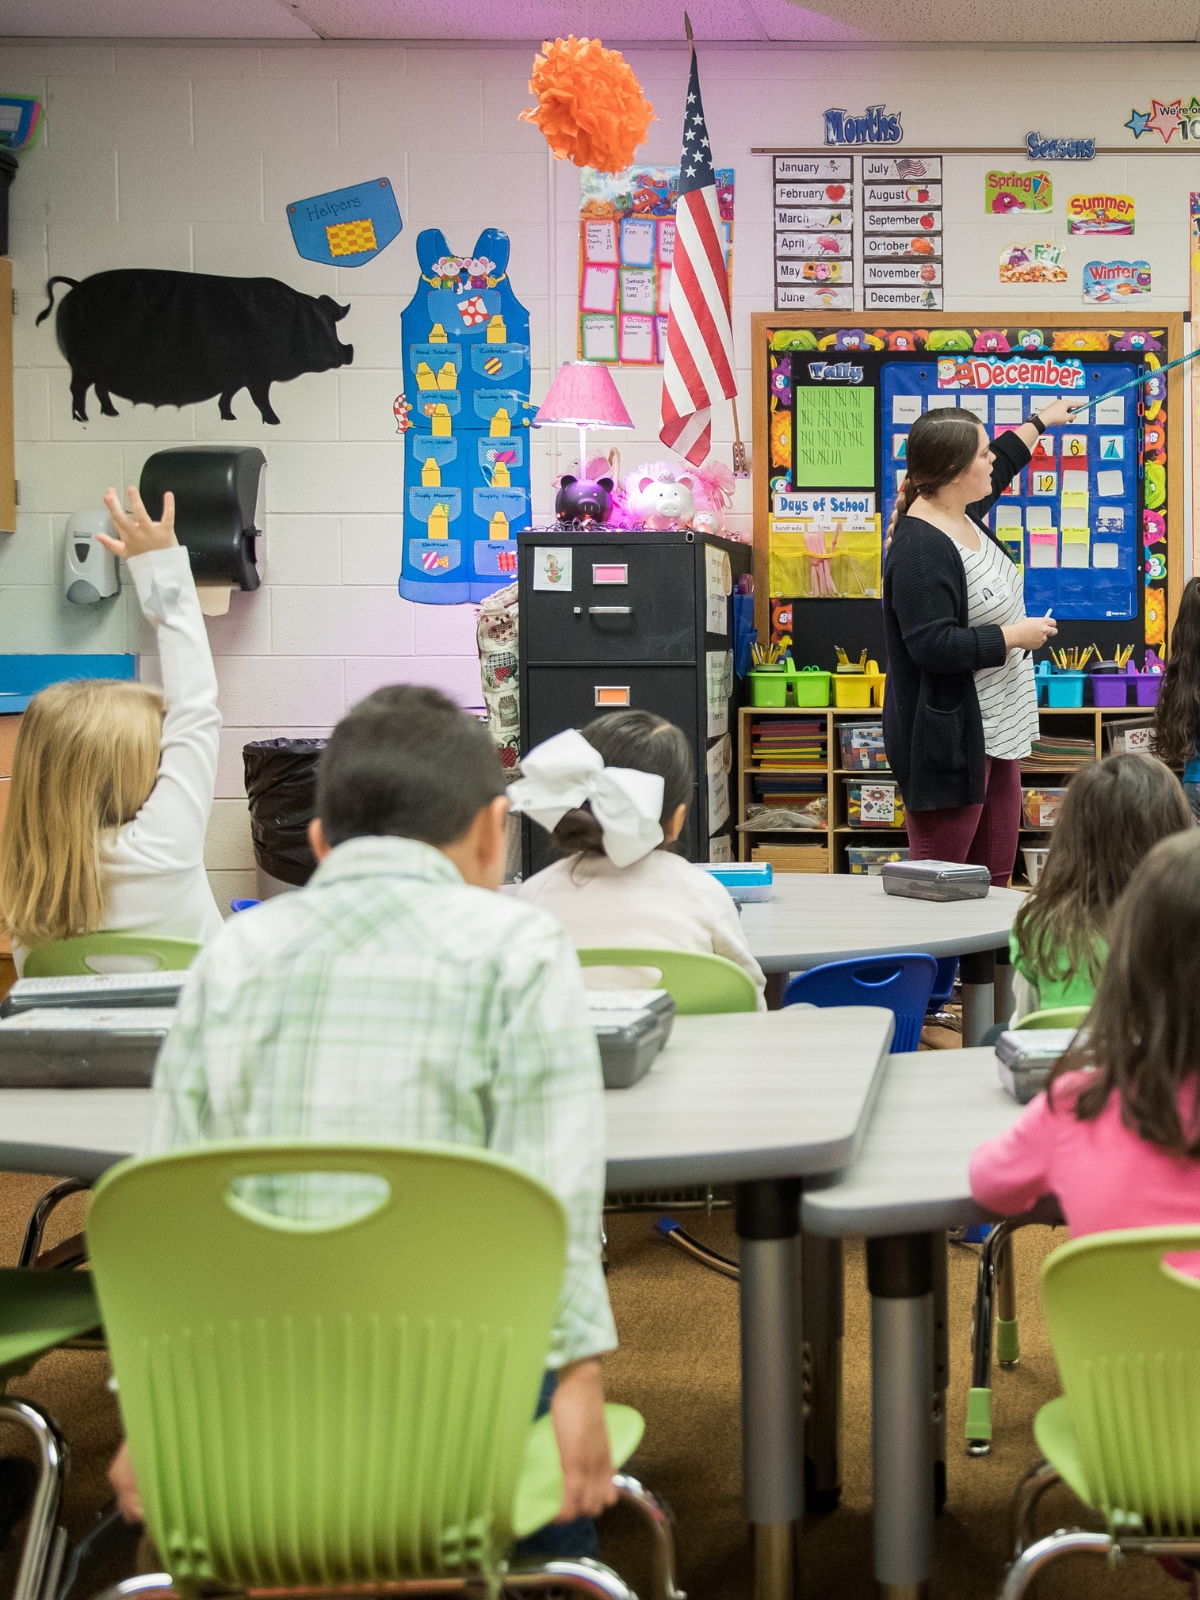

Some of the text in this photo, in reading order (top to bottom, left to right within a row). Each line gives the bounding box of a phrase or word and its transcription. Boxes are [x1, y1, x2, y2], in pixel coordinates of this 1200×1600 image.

[1160, 106, 1188, 116] We're
[824, 105, 902, 145] Months
[1026, 132, 1096, 160] Seasons
[778, 162, 820, 176] January
[868, 163, 889, 176] July
[988, 173, 1032, 192] Spring
[780, 188, 824, 202] February
[868, 189, 905, 202] August
[306, 197, 362, 222] Helpers
[1070, 196, 1134, 216] Summer
[625, 220, 652, 229] February
[778, 213, 810, 225] March
[869, 214, 920, 229] September
[781, 238, 804, 251] April
[869, 240, 909, 252] October
[1034, 244, 1062, 266] Fall
[780, 265, 800, 280] May
[869, 267, 920, 280] November
[1088, 265, 1138, 280] Winter
[781, 292, 805, 304] June
[870, 292, 920, 304] December
[808, 362, 864, 384] Tally
[974, 360, 1082, 388] December
[1038, 438, 1046, 456] 5
[1070, 439, 1080, 456] 6
[1108, 439, 1116, 457] 7
[1037, 475, 1054, 492] 12
[780, 497, 869, 515] Days of School
